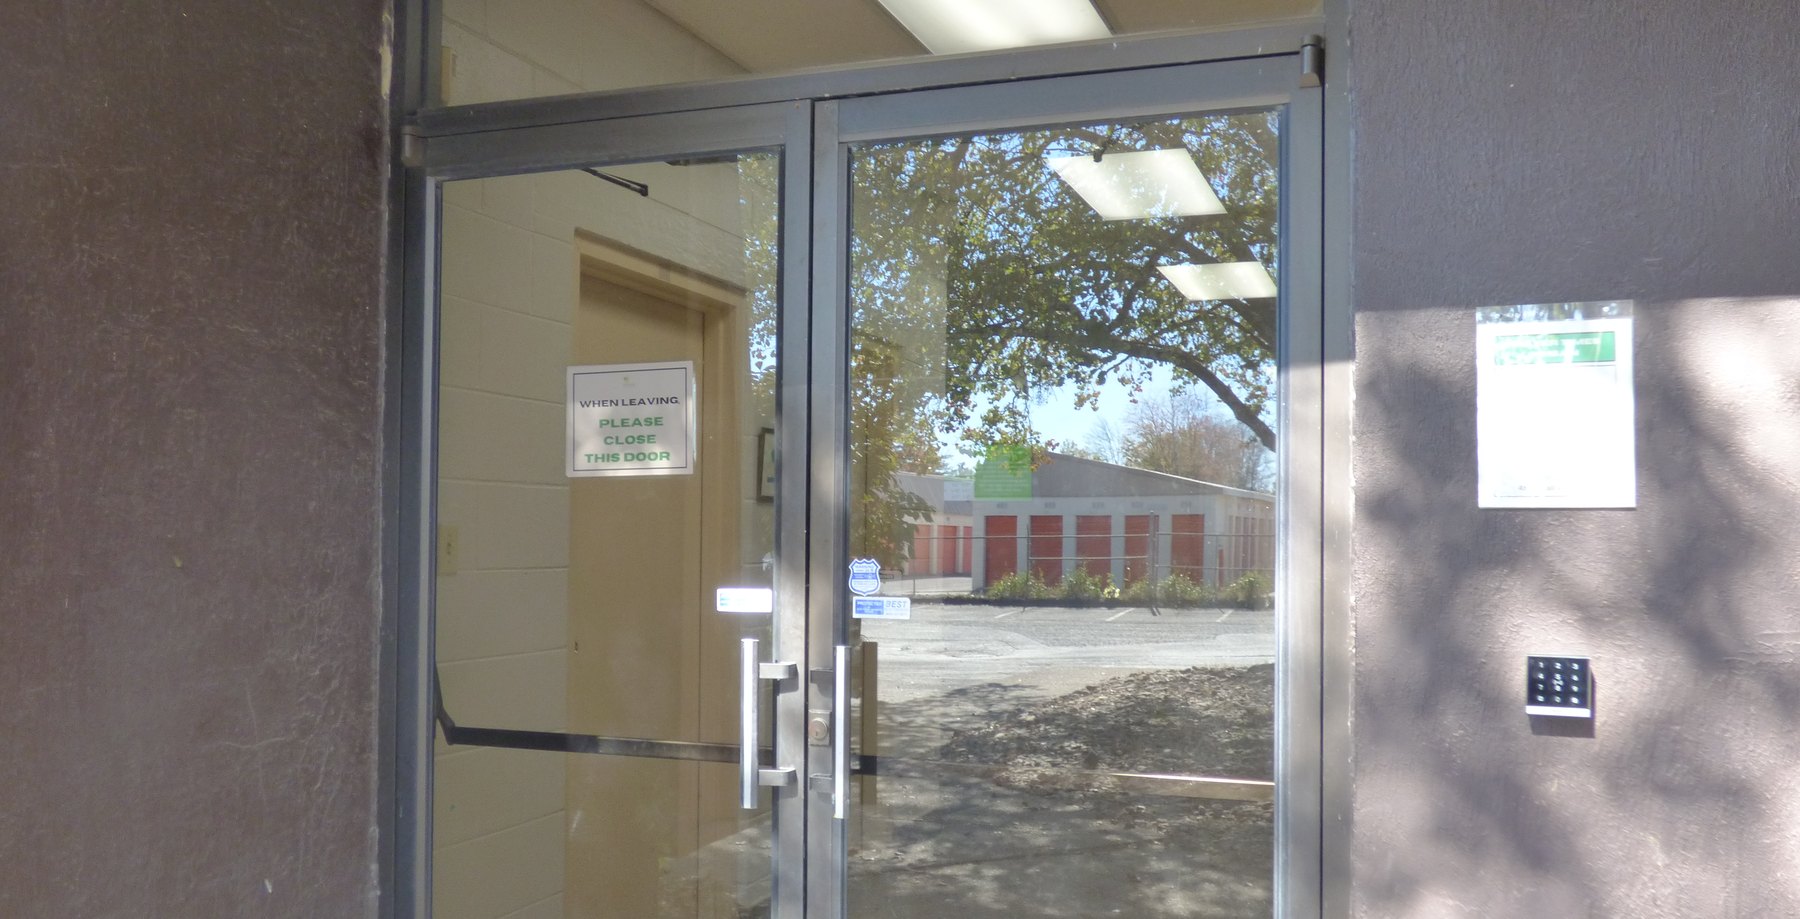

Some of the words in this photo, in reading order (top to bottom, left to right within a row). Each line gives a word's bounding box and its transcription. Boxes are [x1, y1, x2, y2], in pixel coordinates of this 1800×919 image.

[580, 399, 619, 408] WHEN
[599, 416, 664, 429] PLEASE
[603, 434, 657, 446] CLOSE
[584, 452, 621, 463] THIS
[623, 451, 670, 462] DOOR
[885, 600, 907, 608] BEST
